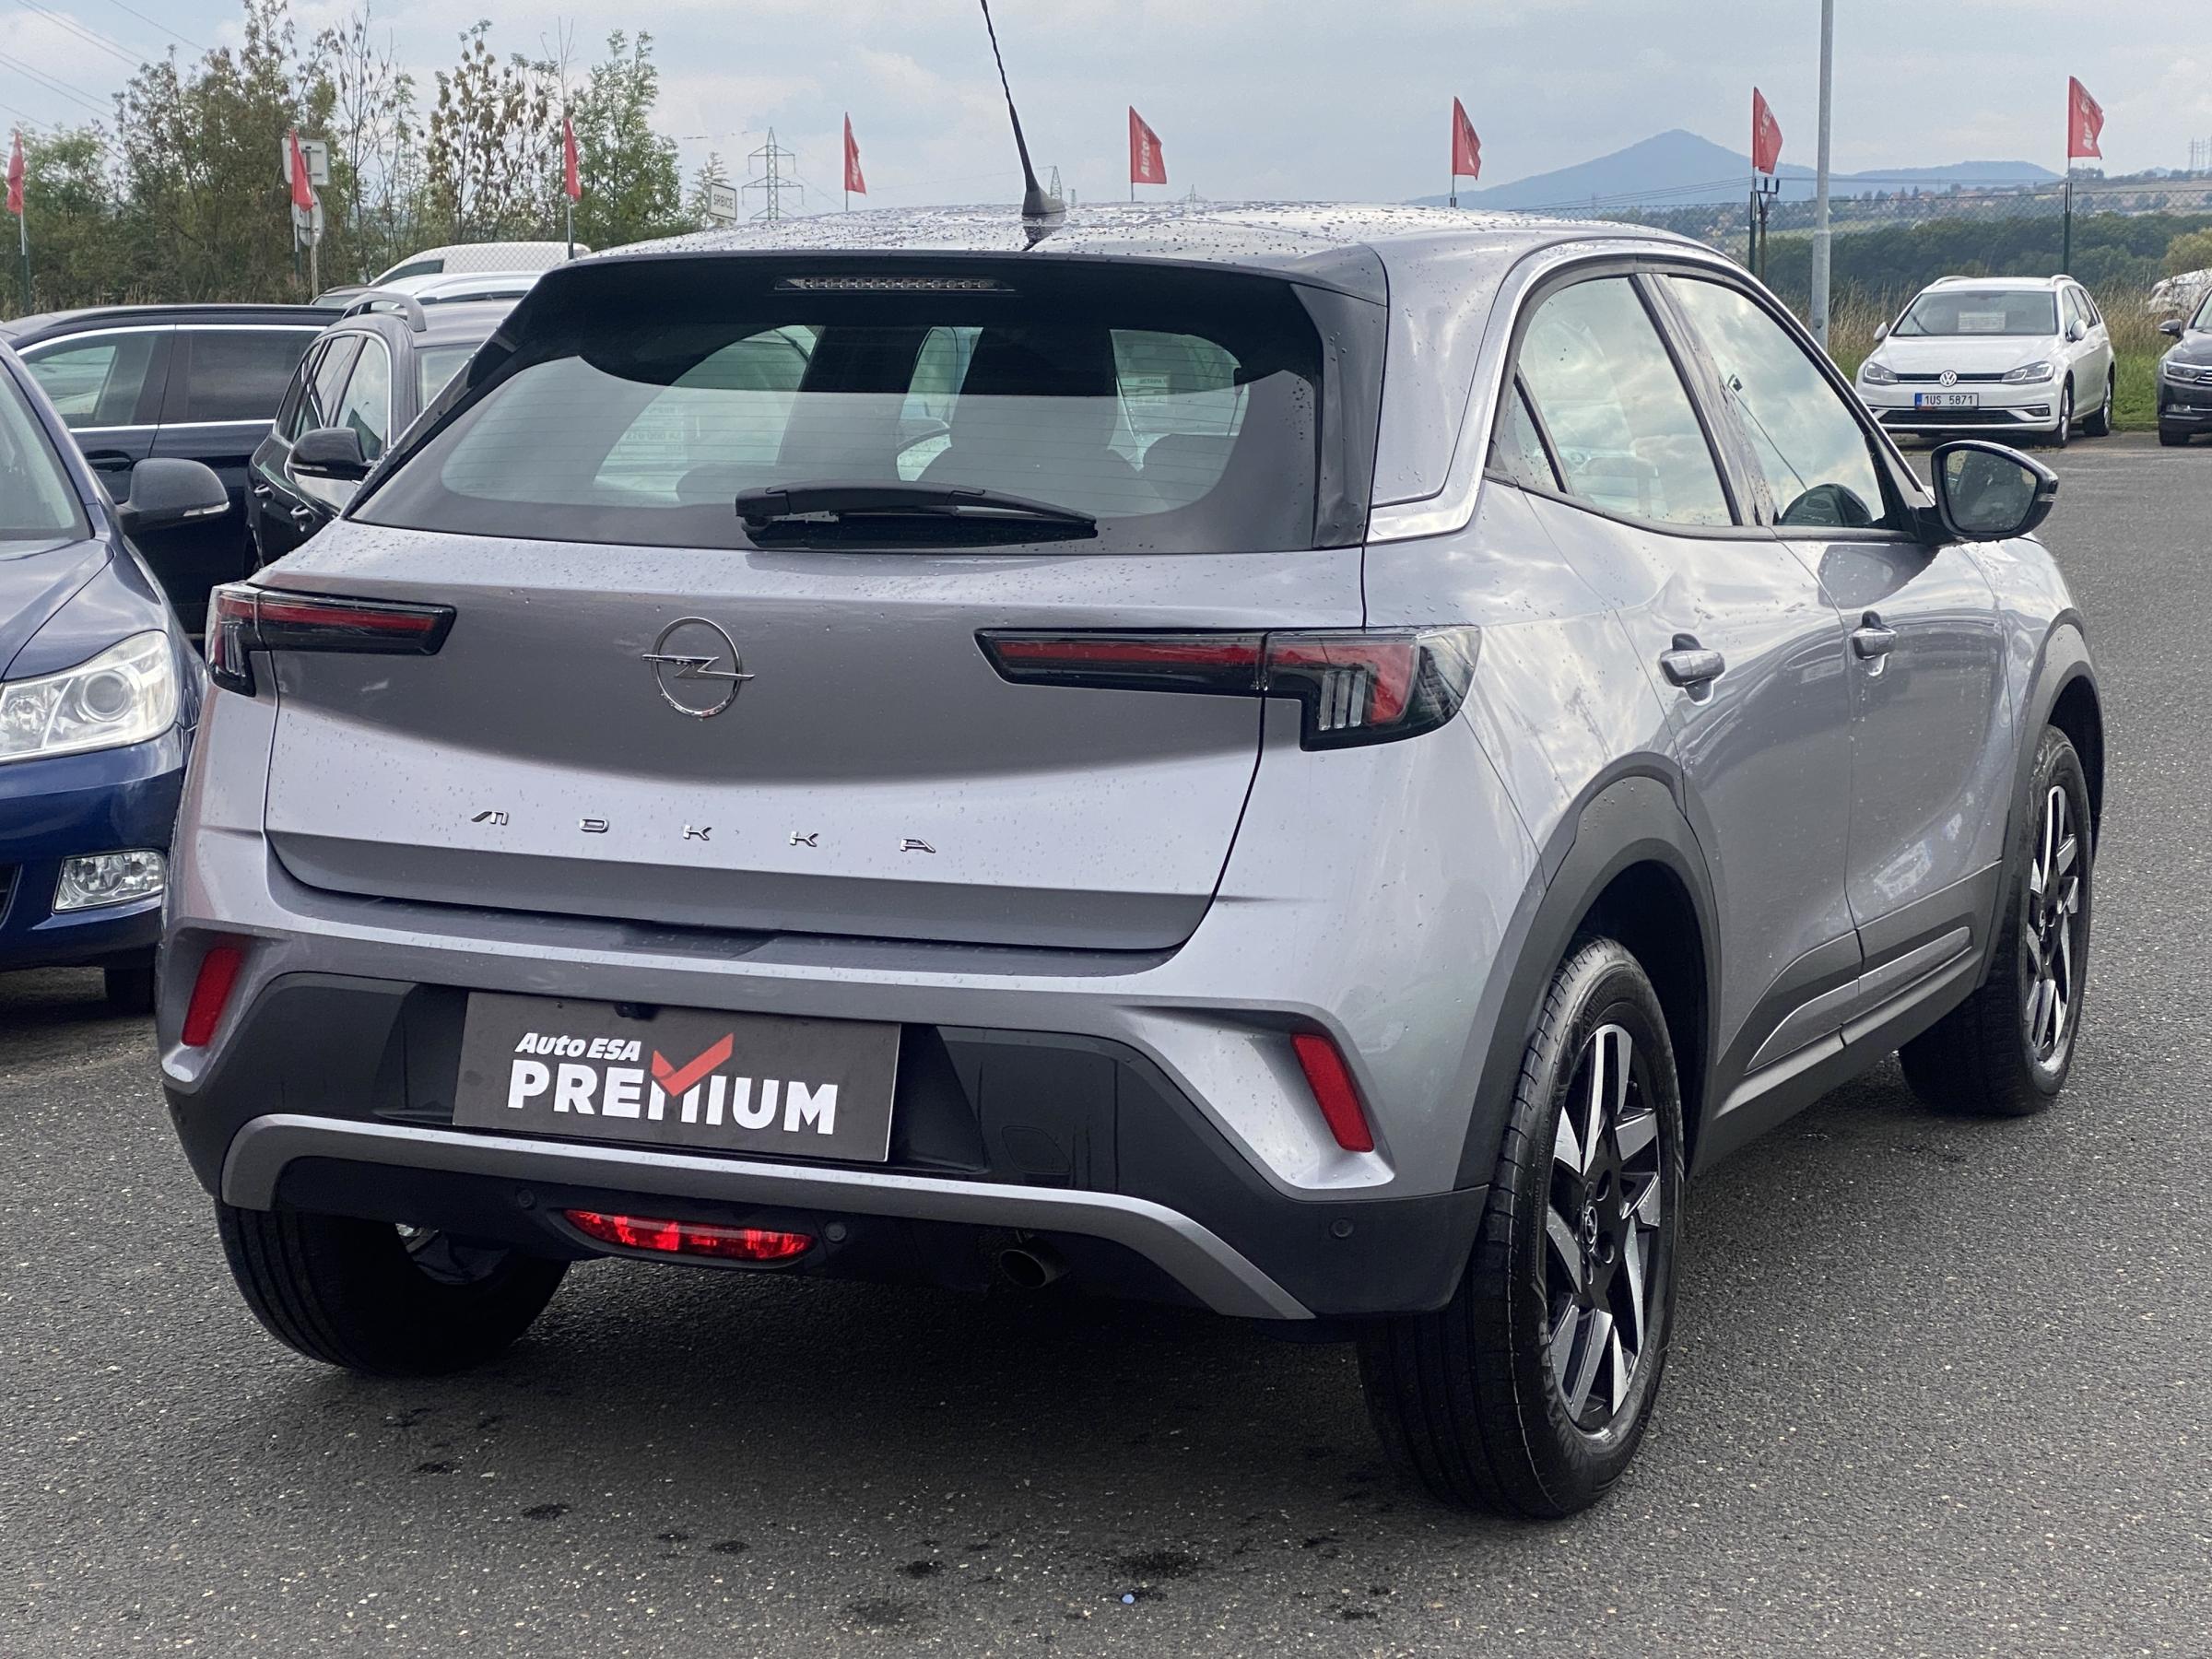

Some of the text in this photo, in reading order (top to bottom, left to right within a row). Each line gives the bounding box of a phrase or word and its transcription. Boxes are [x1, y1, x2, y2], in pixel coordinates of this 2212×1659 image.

[1924, 395, 1973, 406] 1US 5871
[470, 809, 936, 853] MOKKA
[514, 1032, 641, 1062] Auto ESA
[507, 1059, 839, 1135] PREMIUM
